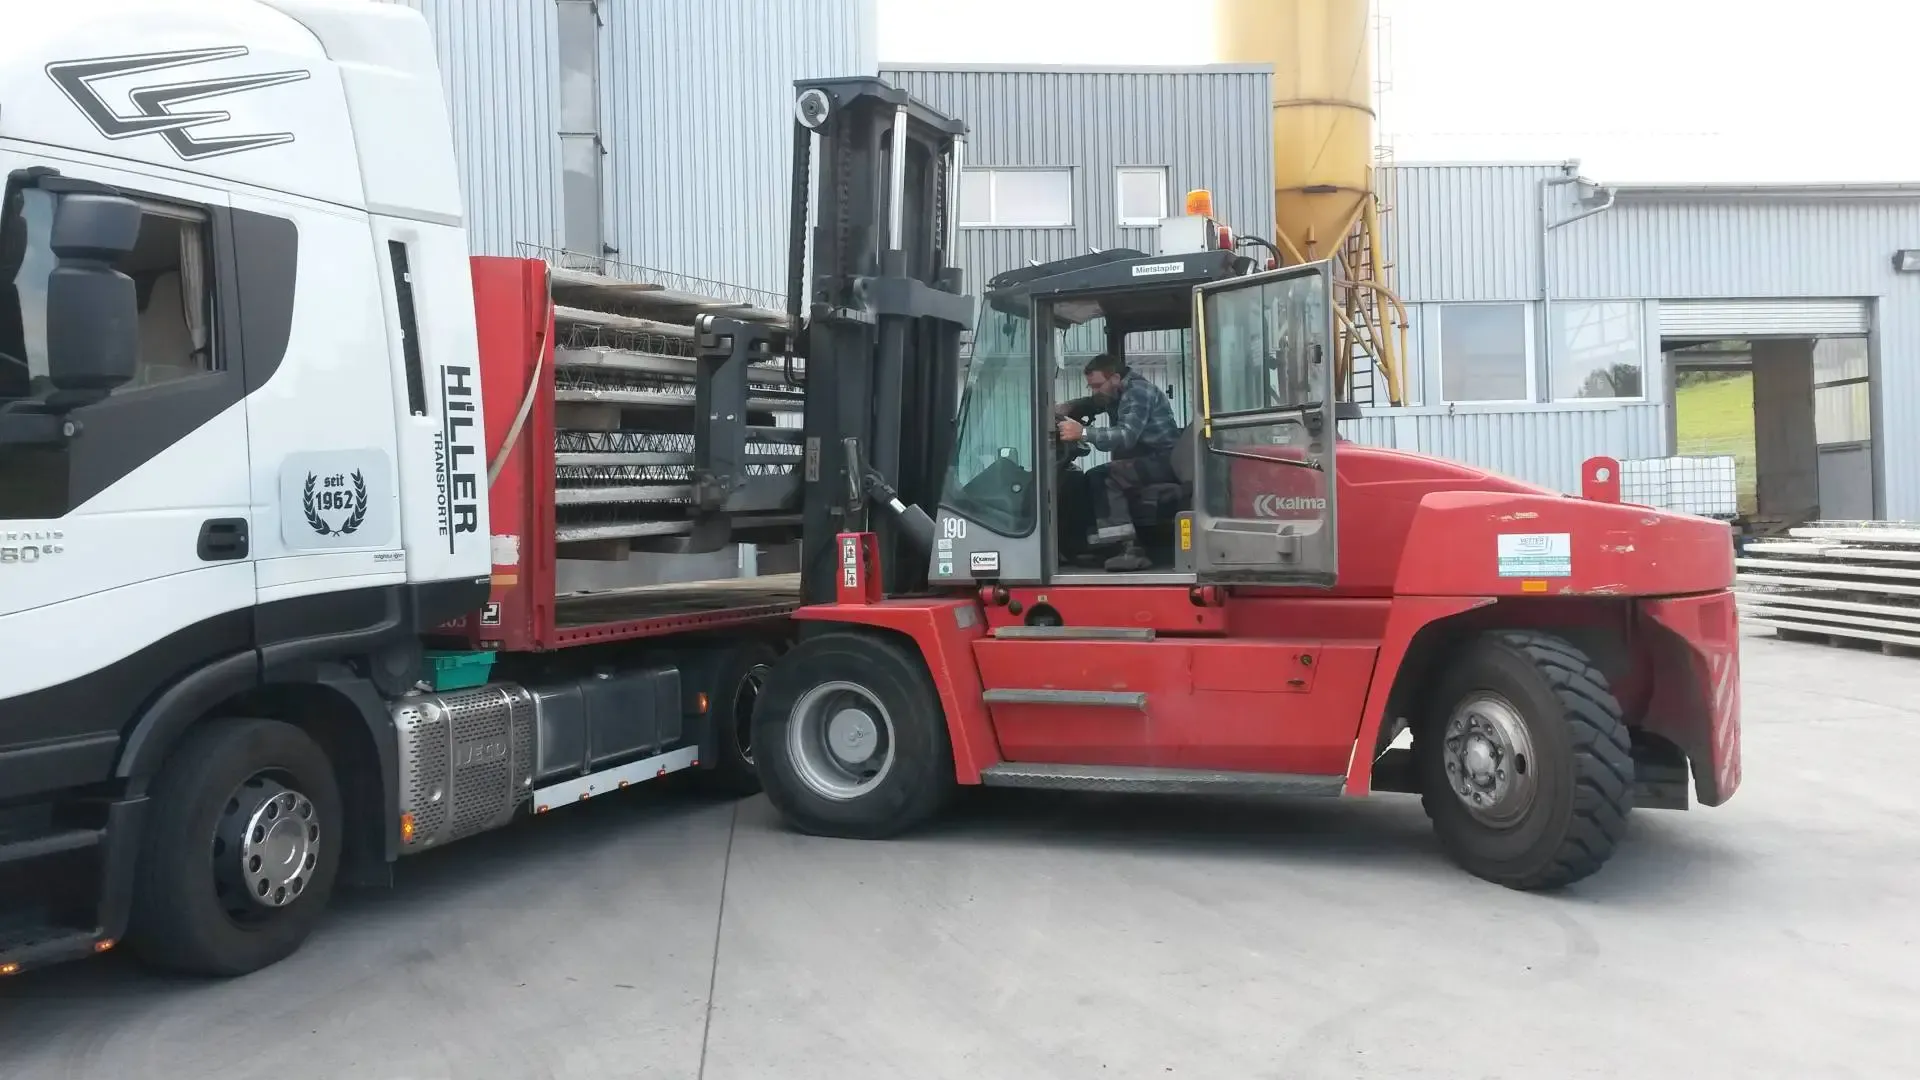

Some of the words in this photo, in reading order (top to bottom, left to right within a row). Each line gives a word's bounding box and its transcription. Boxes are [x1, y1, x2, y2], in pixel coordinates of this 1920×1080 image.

[1135, 264, 1180, 274] Mietstapler
[323, 473, 345, 487] seit
[434, 431, 447, 536] TRANSPORTE
[315, 490, 354, 510] 1962
[942, 517, 967, 539] 190
